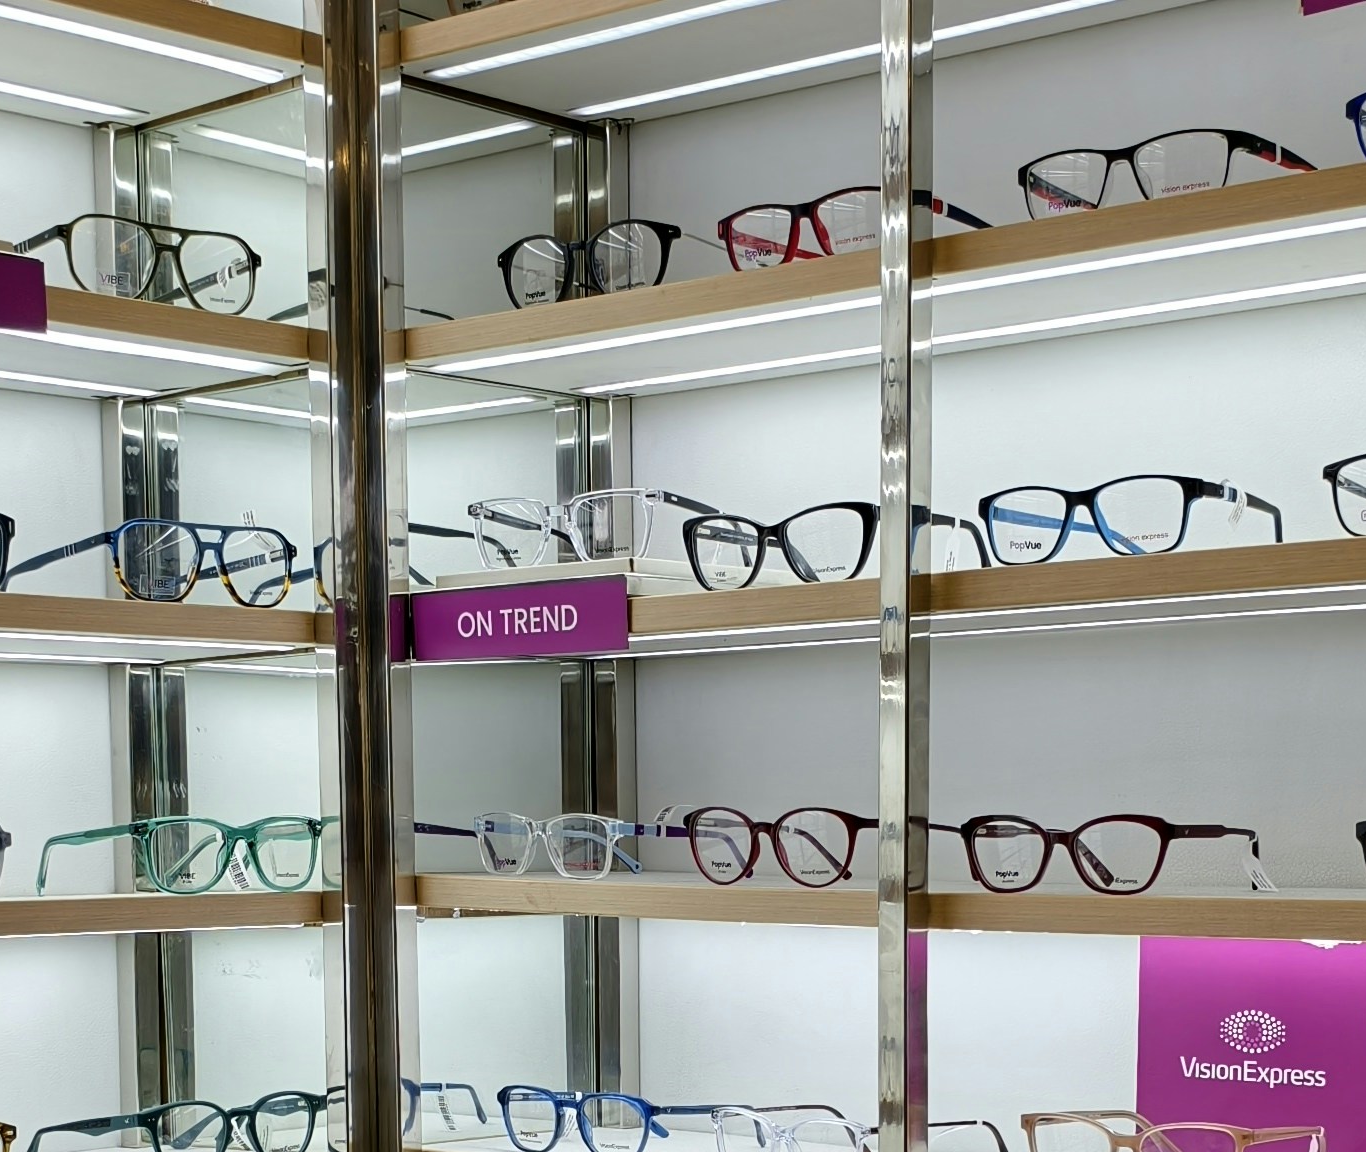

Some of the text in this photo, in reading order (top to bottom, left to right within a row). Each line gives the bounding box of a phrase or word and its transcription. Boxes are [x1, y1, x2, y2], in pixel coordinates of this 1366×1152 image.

[1161, 181, 1210, 194] vision express
[1048, 199, 1081, 212] PopVue
[99, 272, 123, 285] VIBE
[1141, 532, 1169, 541] express
[1010, 541, 1042, 552] PopVue
[457, 604, 578, 638] ON TREND
[1180, 1056, 1326, 1089] VisionExpress
